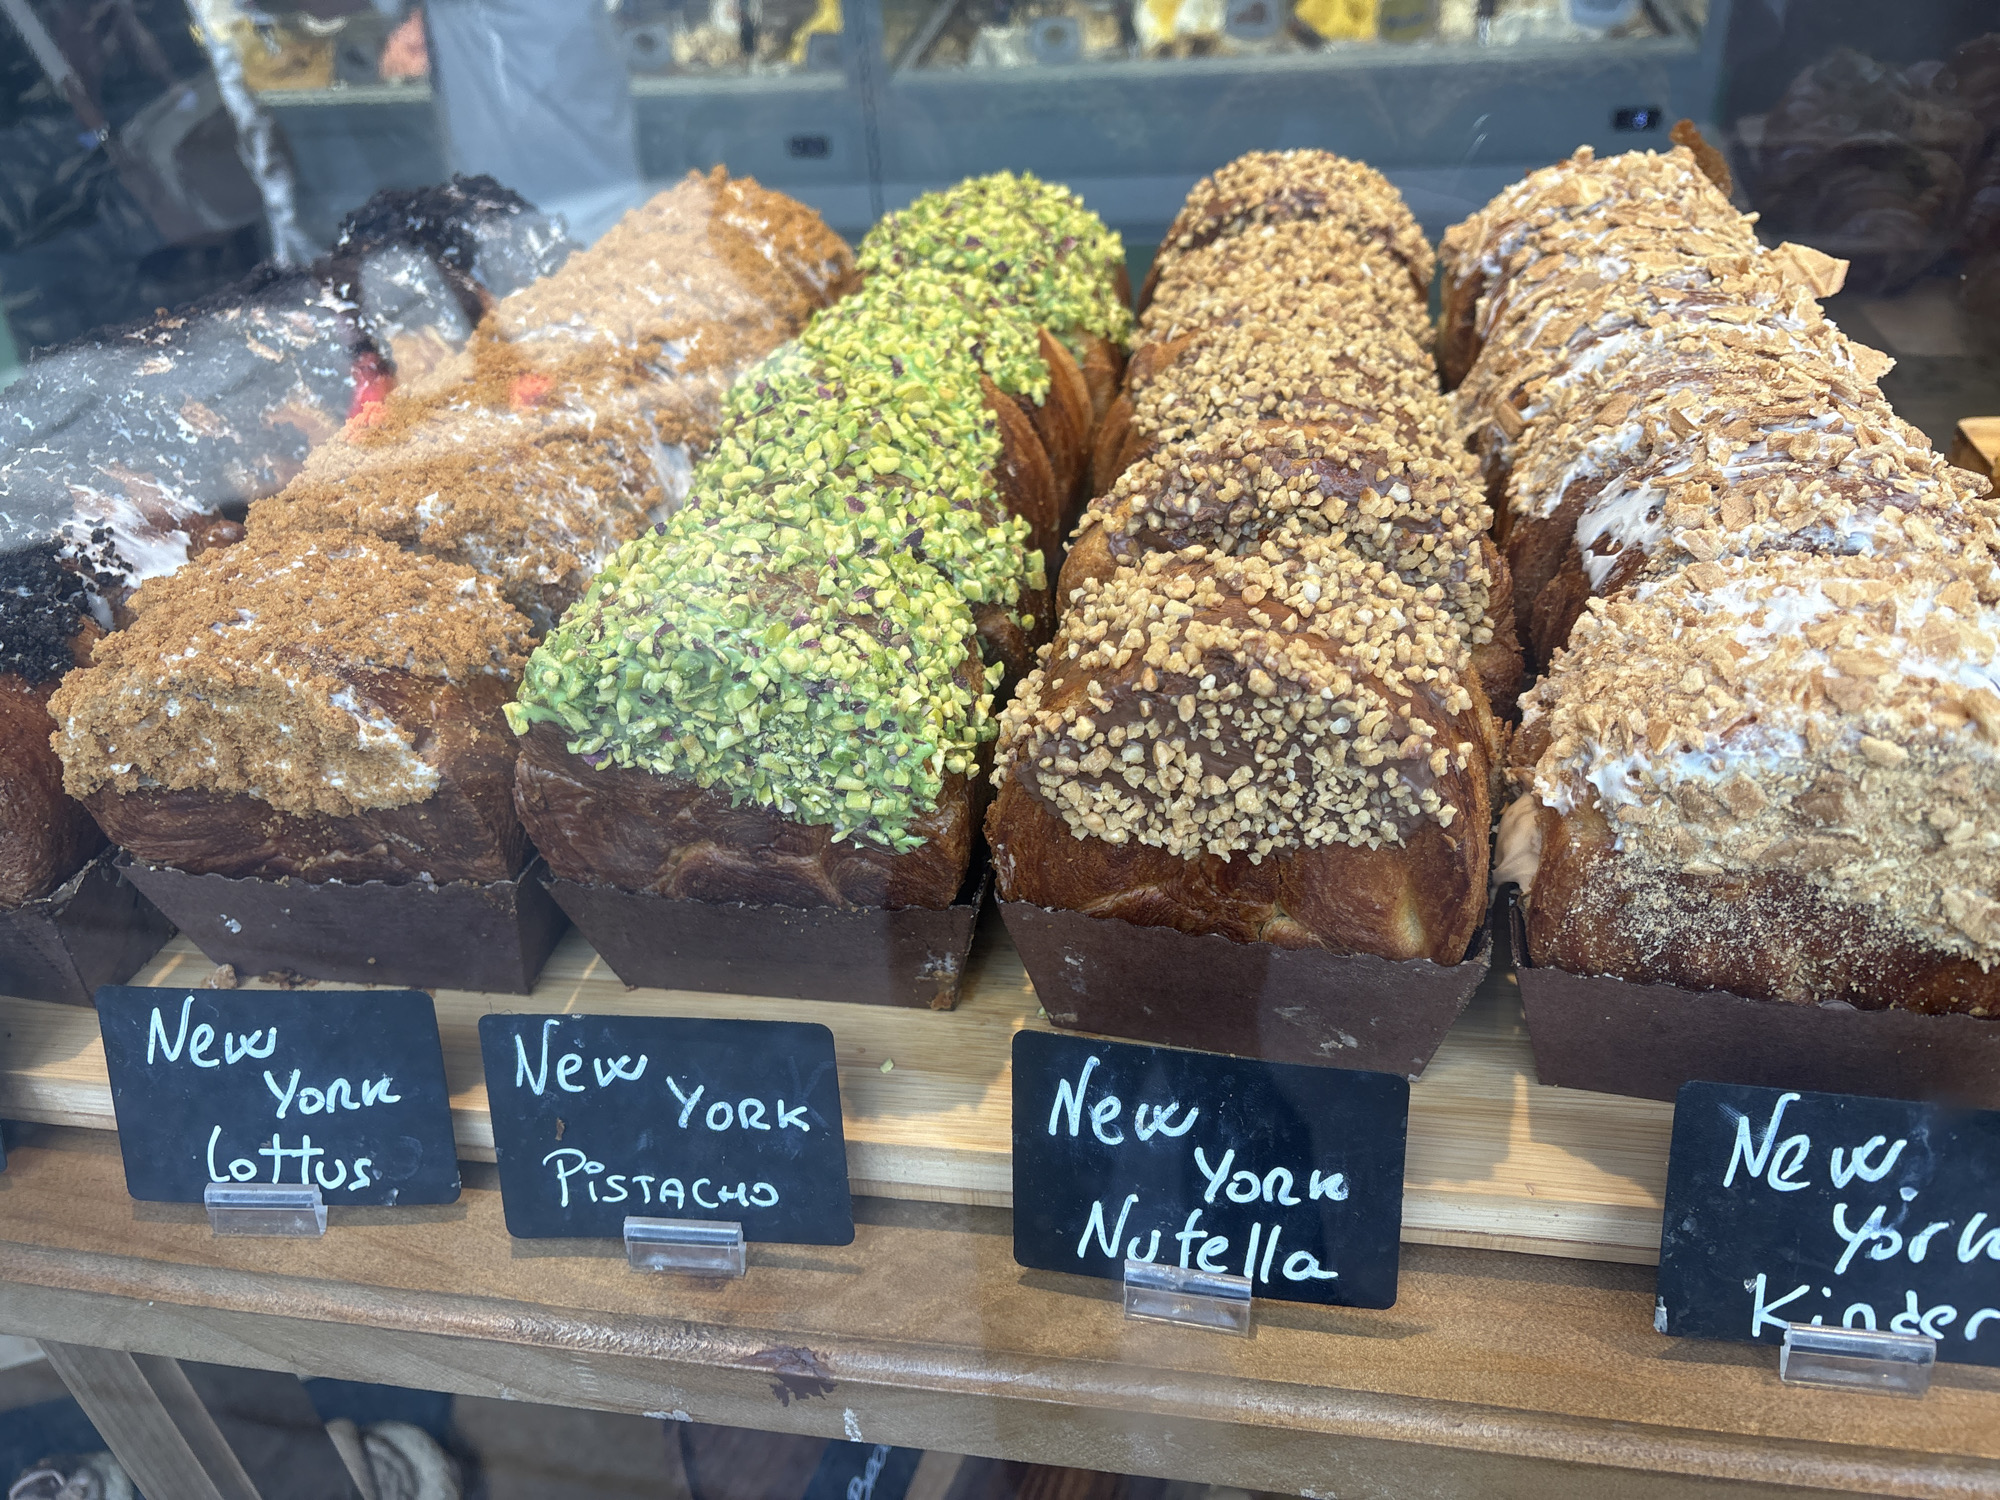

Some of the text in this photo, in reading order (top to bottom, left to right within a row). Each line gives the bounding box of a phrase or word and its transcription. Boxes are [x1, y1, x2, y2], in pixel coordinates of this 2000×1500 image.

[148, 996, 278, 1068] New
[515, 1019, 648, 1096] New
[666, 1075, 810, 1131] YORK
[1048, 1055, 1199, 1145] New
[1722, 1092, 1907, 1191] New
[1077, 1194, 1339, 1284] Nutella
